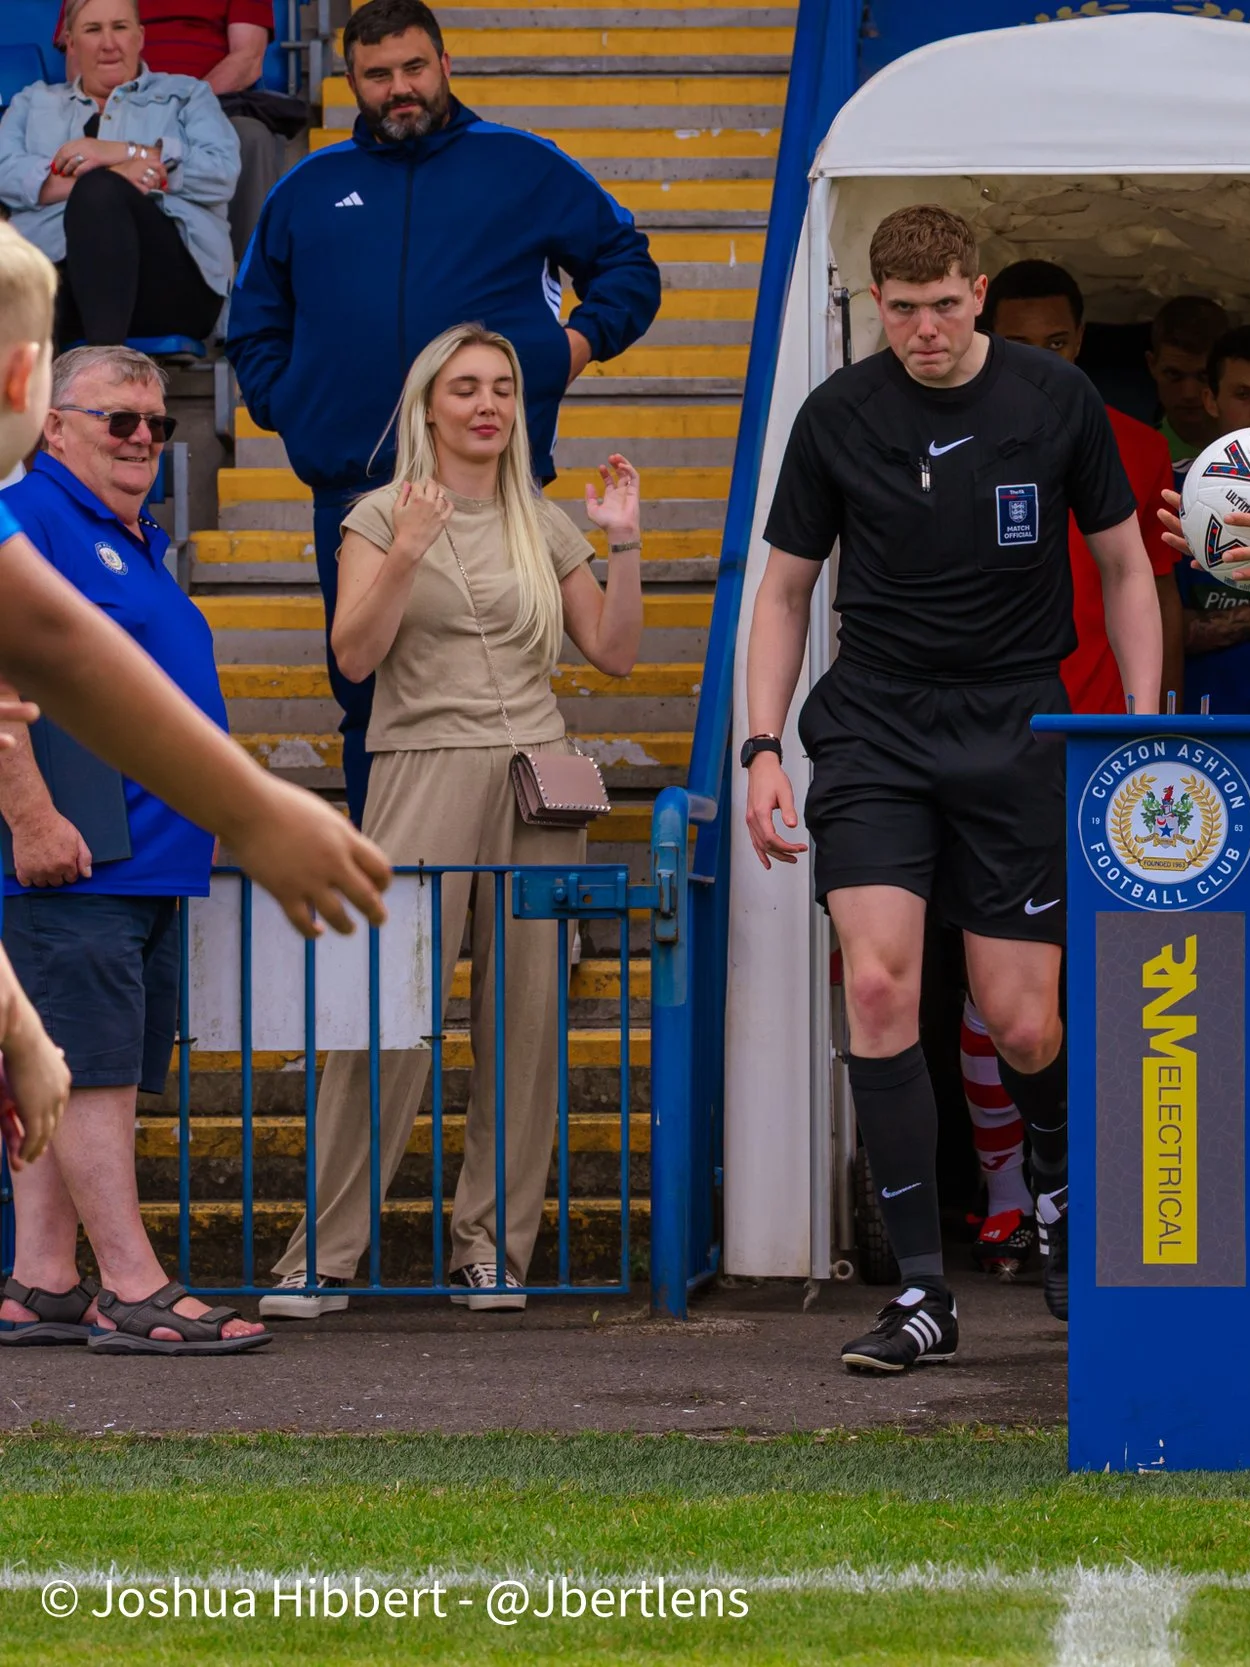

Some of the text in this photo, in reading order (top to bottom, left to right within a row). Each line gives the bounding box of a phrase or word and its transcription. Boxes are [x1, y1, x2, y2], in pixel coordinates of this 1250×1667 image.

[1004, 532, 1033, 540] OFFICIAL
[1092, 741, 1246, 810] CURZON ASHTON
[1091, 817, 1101, 825] 19
[1234, 824, 1243, 832] 63
[1143, 860, 1171, 868] FOUNDED
[1090, 842, 1240, 904] FOOTBALL CLUB
[1158, 1065, 1182, 1256] ELECTRICAL
